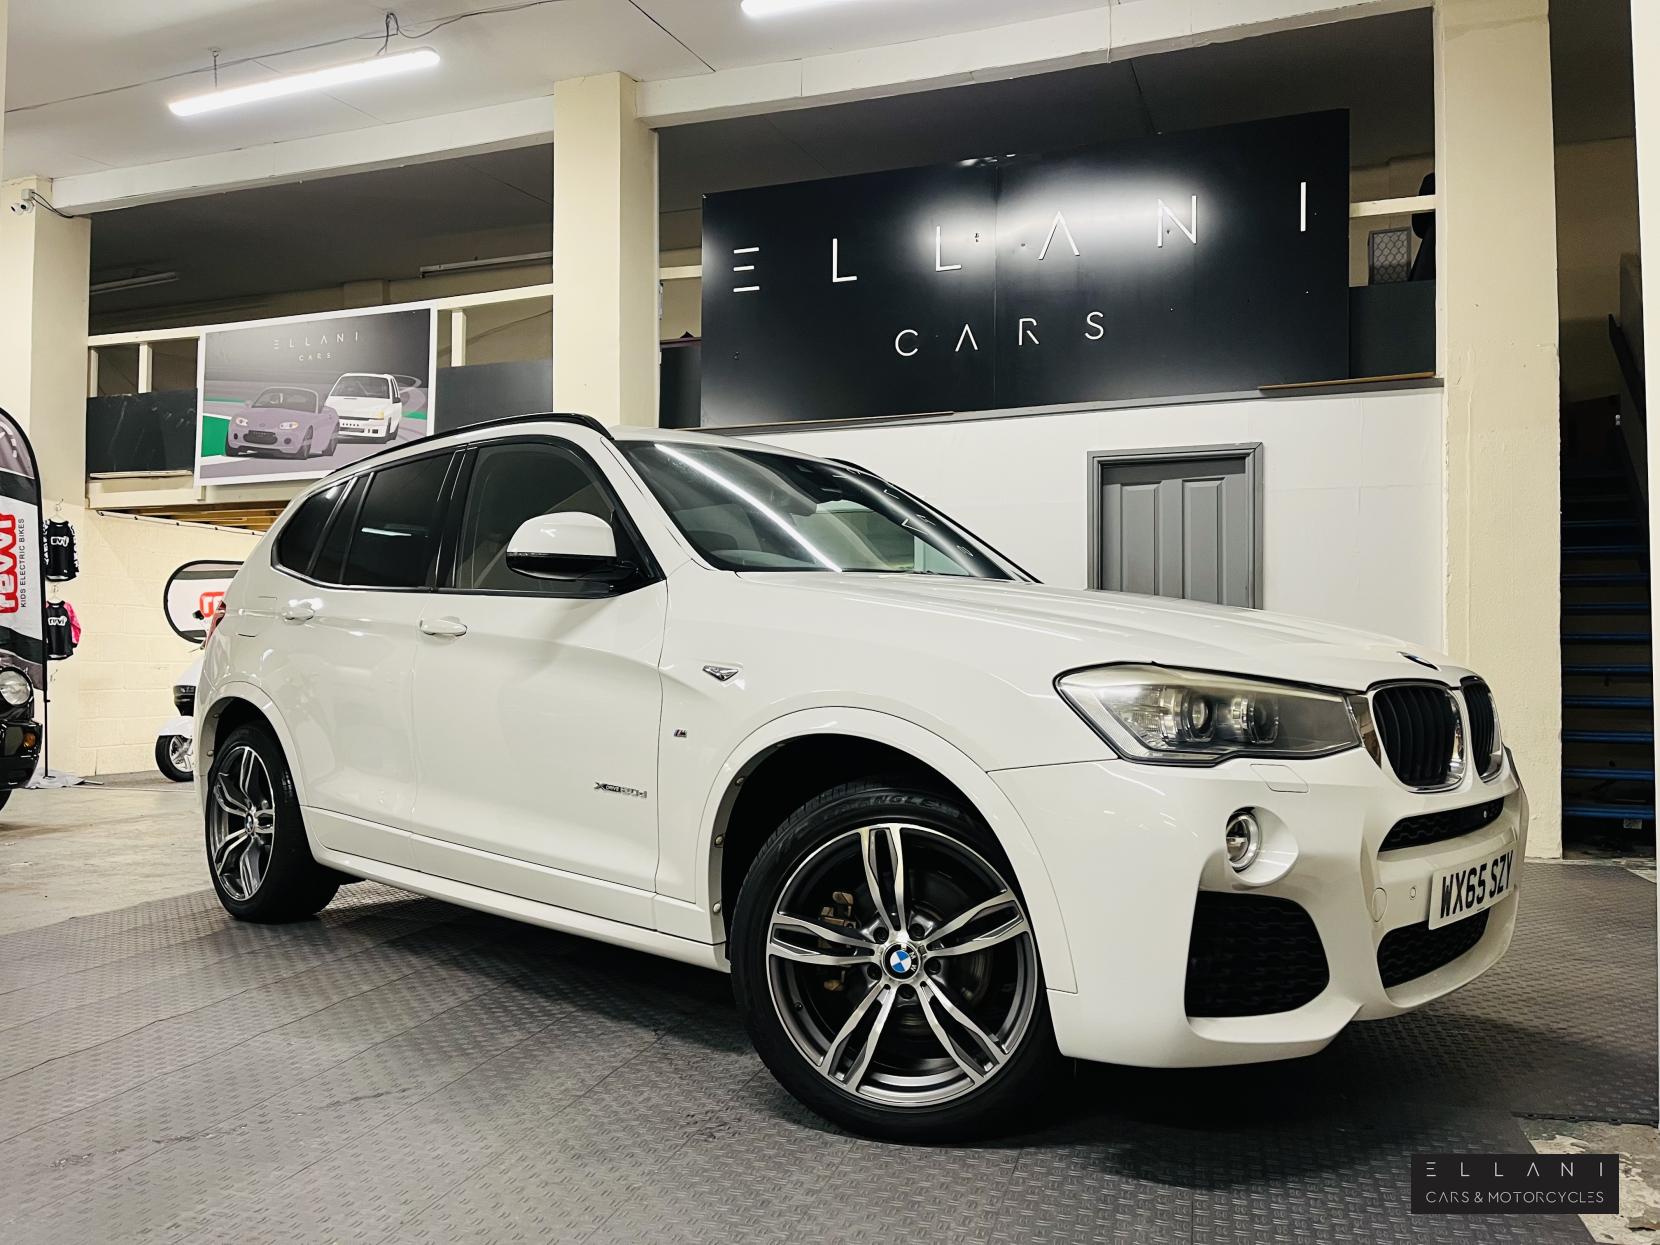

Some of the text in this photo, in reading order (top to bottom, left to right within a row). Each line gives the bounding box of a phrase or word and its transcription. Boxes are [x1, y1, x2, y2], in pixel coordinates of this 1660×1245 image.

[733, 181, 1307, 293] ELLANI
[273, 330, 359, 350] ELLANI
[895, 311, 1104, 356] CARS
[298, 352, 332, 361] CARS
[1440, 850, 1514, 918] WX65 SZY
